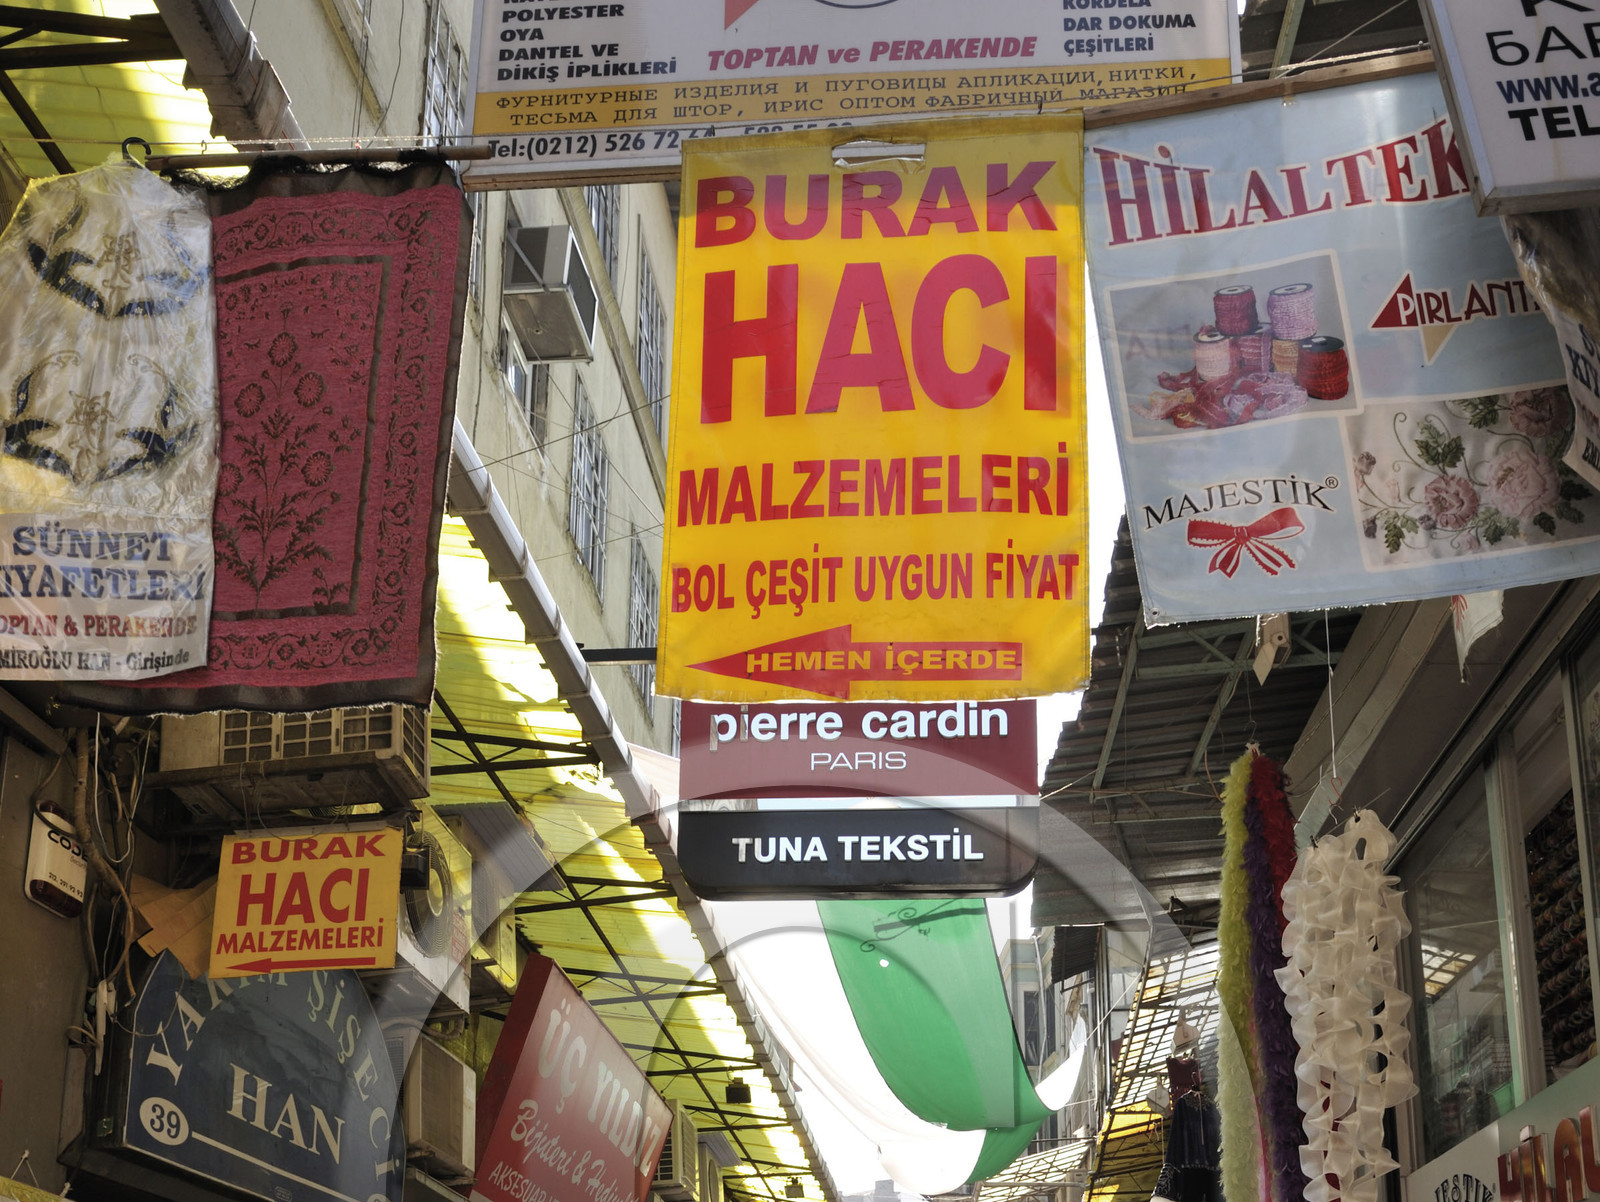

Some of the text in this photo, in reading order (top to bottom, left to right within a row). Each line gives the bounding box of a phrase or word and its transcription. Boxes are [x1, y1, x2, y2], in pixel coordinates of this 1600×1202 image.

[502, 4, 625, 23] POLYESTER
[1063, 14, 1196, 31] DAR DOKUMA
[499, 43, 619, 62] DANTEL VE
[500, 28, 544, 42] OYA
[1063, 33, 1154, 57] ÇEŞİTLERİ
[497, 57, 677, 82] DİKİŞ İPLİKLERİ
[708, 36, 1038, 71] TOPTAN ve PERAKENDE
[496, 89, 658, 109] ФУРНИТУРНЫЕ
[673, 82, 779, 100] ИЗДЕЛИЯ
[795, 81, 809, 93] И
[825, 77, 946, 93] ПУГОВИЦЫ
[510, 111, 598, 126] ТЕСЬМА
[613, 108, 657, 124] ДЛЯ
[764, 99, 823, 114] ИРИС
[839, 96, 916, 110] ОПТОМ
[925, 88, 1063, 108] ФАБРИЧНЫЙ
[1079, 83, 1187, 100] МАГАЗИН
[604, 132, 645, 152] 526
[653, 131, 680, 149] 72
[695, 160, 1057, 249] BURAK
[1397, 279, 1541, 325] PIRLANT
[700, 254, 1058, 425] HACI
[677, 441, 1069, 528] MALZEMELERİ
[1144, 474, 1335, 531] MAJESTİK
[13, 520, 174, 562] SÜNNET
[671, 538, 1080, 620] BOL ÇEŞİT UYGUN FİYAT
[63, 615, 78, 637] &
[83, 613, 198, 638] PERAKENDE
[126, 648, 190, 673] Girişinde
[746, 644, 1018, 676] HEMEN İÇERDE
[709, 699, 1008, 751] pierre cardin
[810, 751, 907, 771] PARIS
[231, 833, 386, 865] BURAK
[732, 827, 984, 863] TUNA TEKSTİL
[236, 867, 371, 927] HACI
[216, 917, 385, 955] MALZEMELERİ
[537, 998, 662, 1178] ÜÇ YILDIZ
[150, 1103, 181, 1139] 39
[226, 1062, 346, 1165] HAN
